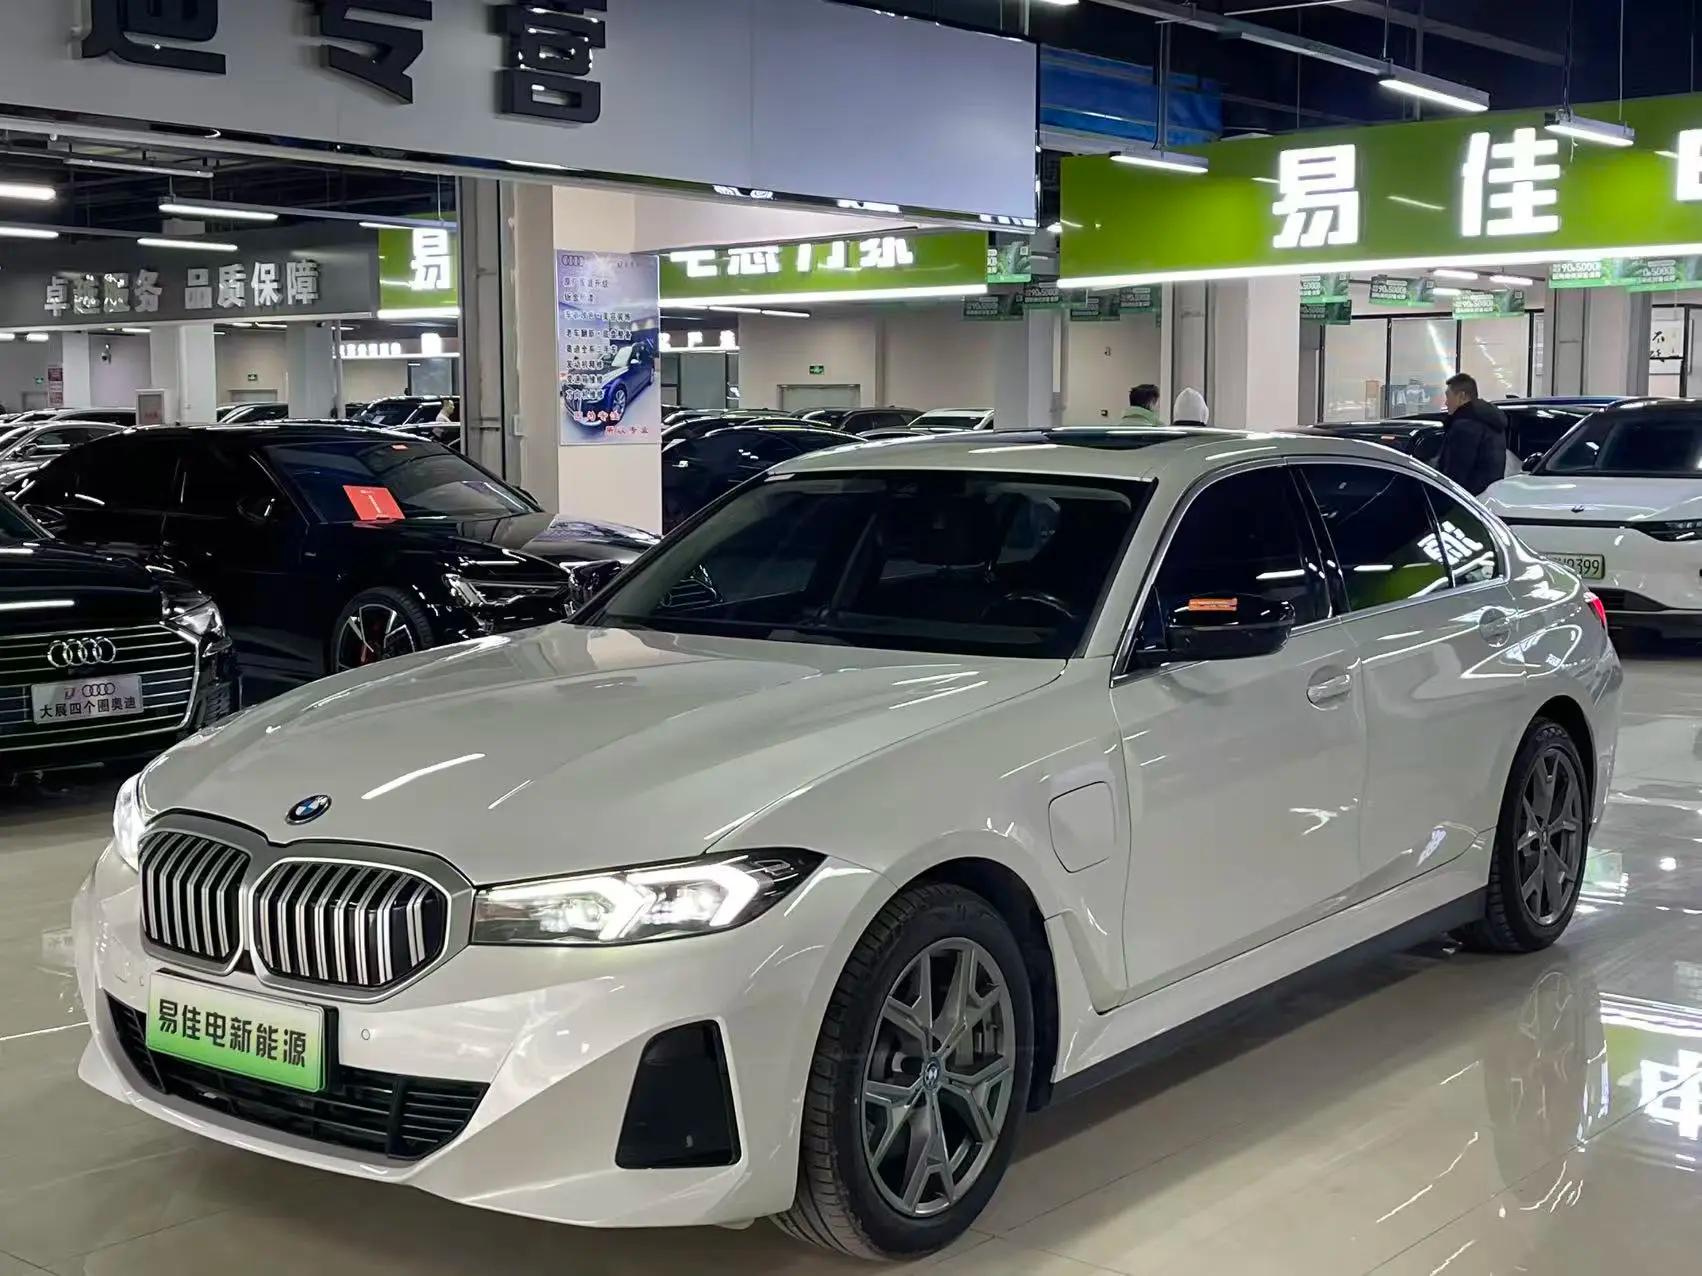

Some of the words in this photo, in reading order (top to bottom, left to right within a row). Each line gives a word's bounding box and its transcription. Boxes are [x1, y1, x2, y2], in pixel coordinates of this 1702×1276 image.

[1272, 127, 1702, 249] 易佳
[184, 258, 319, 309] 品质保障
[410, 228, 452, 291] 易
[158, 998, 307, 1068] 易佳电新能源
